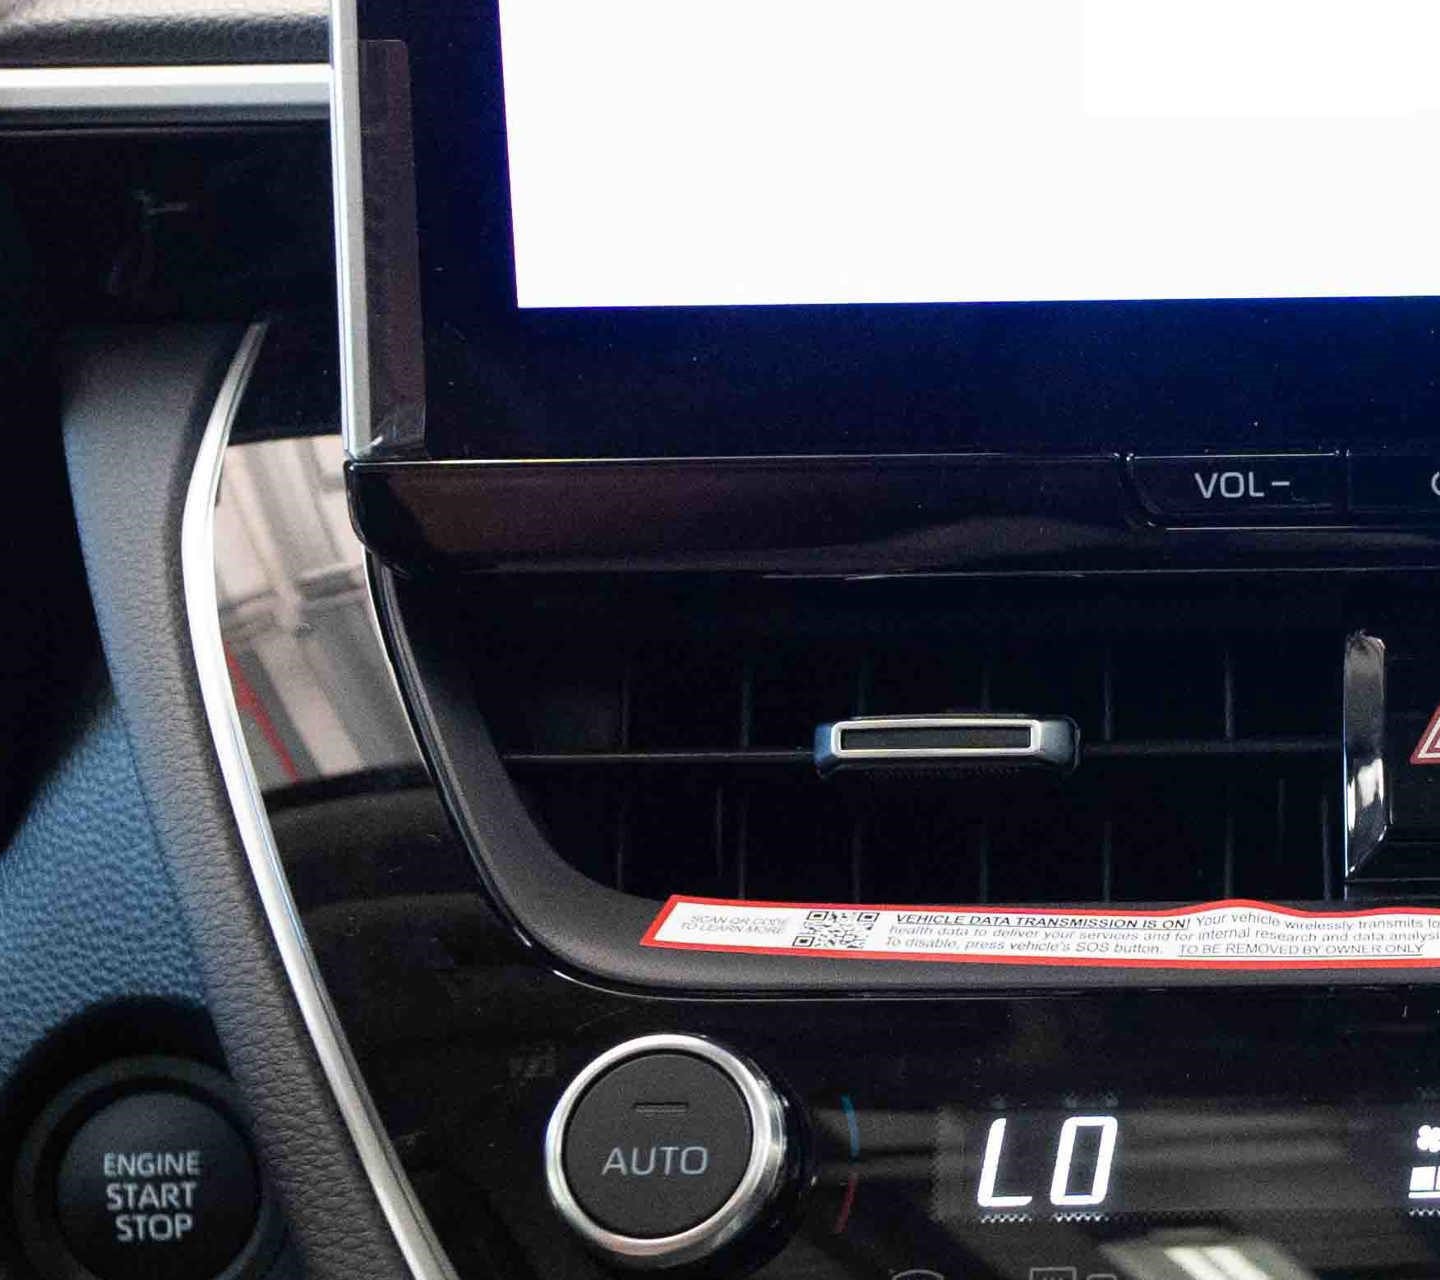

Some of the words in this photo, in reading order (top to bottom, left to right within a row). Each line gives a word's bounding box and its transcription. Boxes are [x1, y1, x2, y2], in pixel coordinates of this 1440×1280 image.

[896, 913, 966, 925] VEHICLE
[968, 915, 1010, 926] DATA
[1015, 917, 1138, 929] TRANSMISSION
[1142, 919, 1158, 929] IS
[1074, 942, 1110, 953] SOS
[103, 1151, 200, 1177] ENGINE
[601, 1144, 709, 1178] AUTO
[106, 1181, 197, 1211] START
[115, 1214, 193, 1242] STOP
